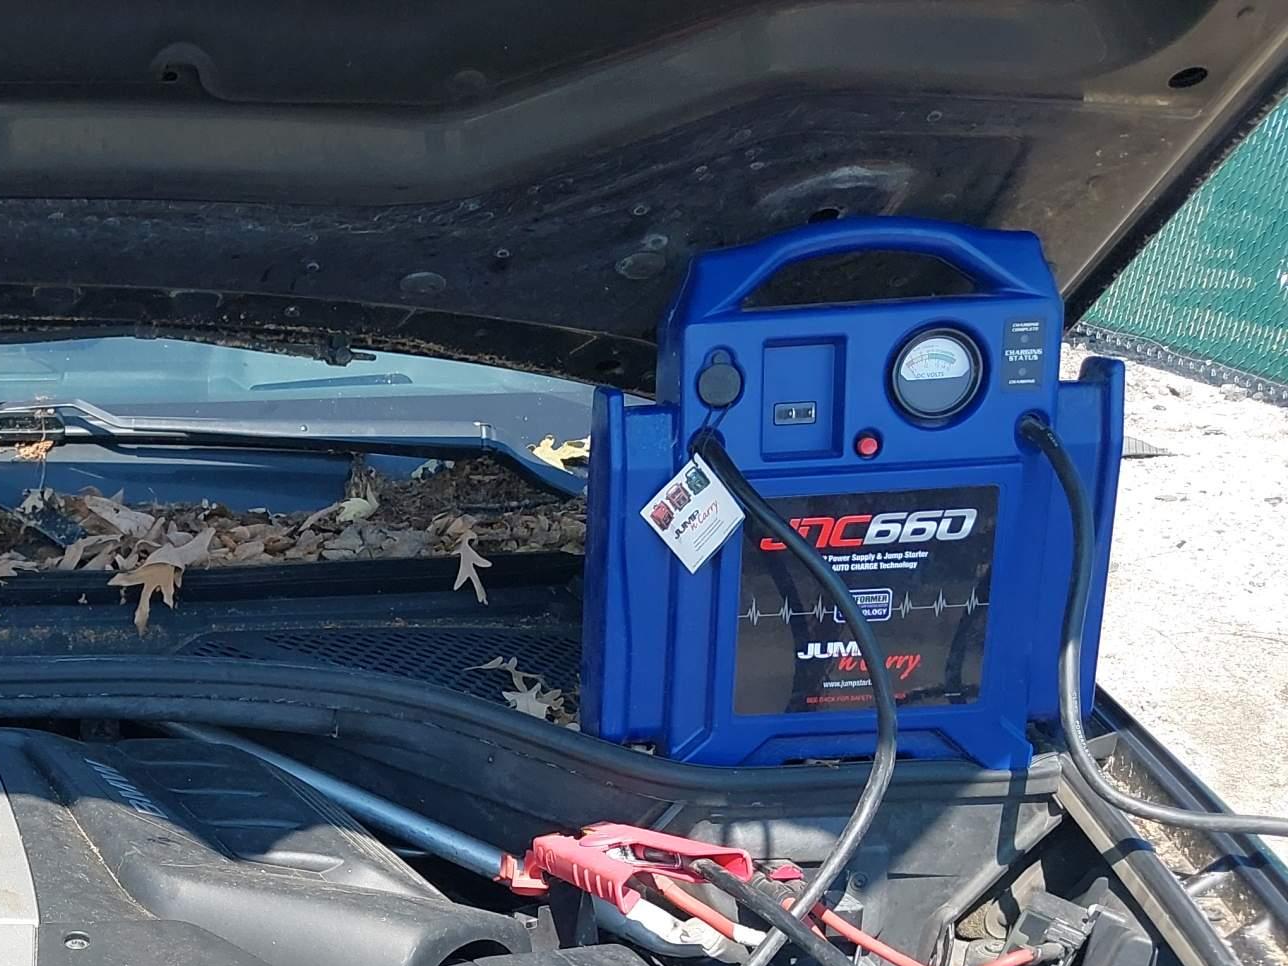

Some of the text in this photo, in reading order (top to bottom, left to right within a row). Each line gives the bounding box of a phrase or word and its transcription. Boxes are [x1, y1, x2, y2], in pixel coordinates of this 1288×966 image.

[674, 509, 700, 540] JUMP
[828, 550, 929, 563] Power Supply & Jump Starter
[850, 562, 878, 571] CHARGE
[879, 560, 918, 570] Technology
[855, 594, 888, 603] FORMER
[797, 641, 862, 660] JUM
